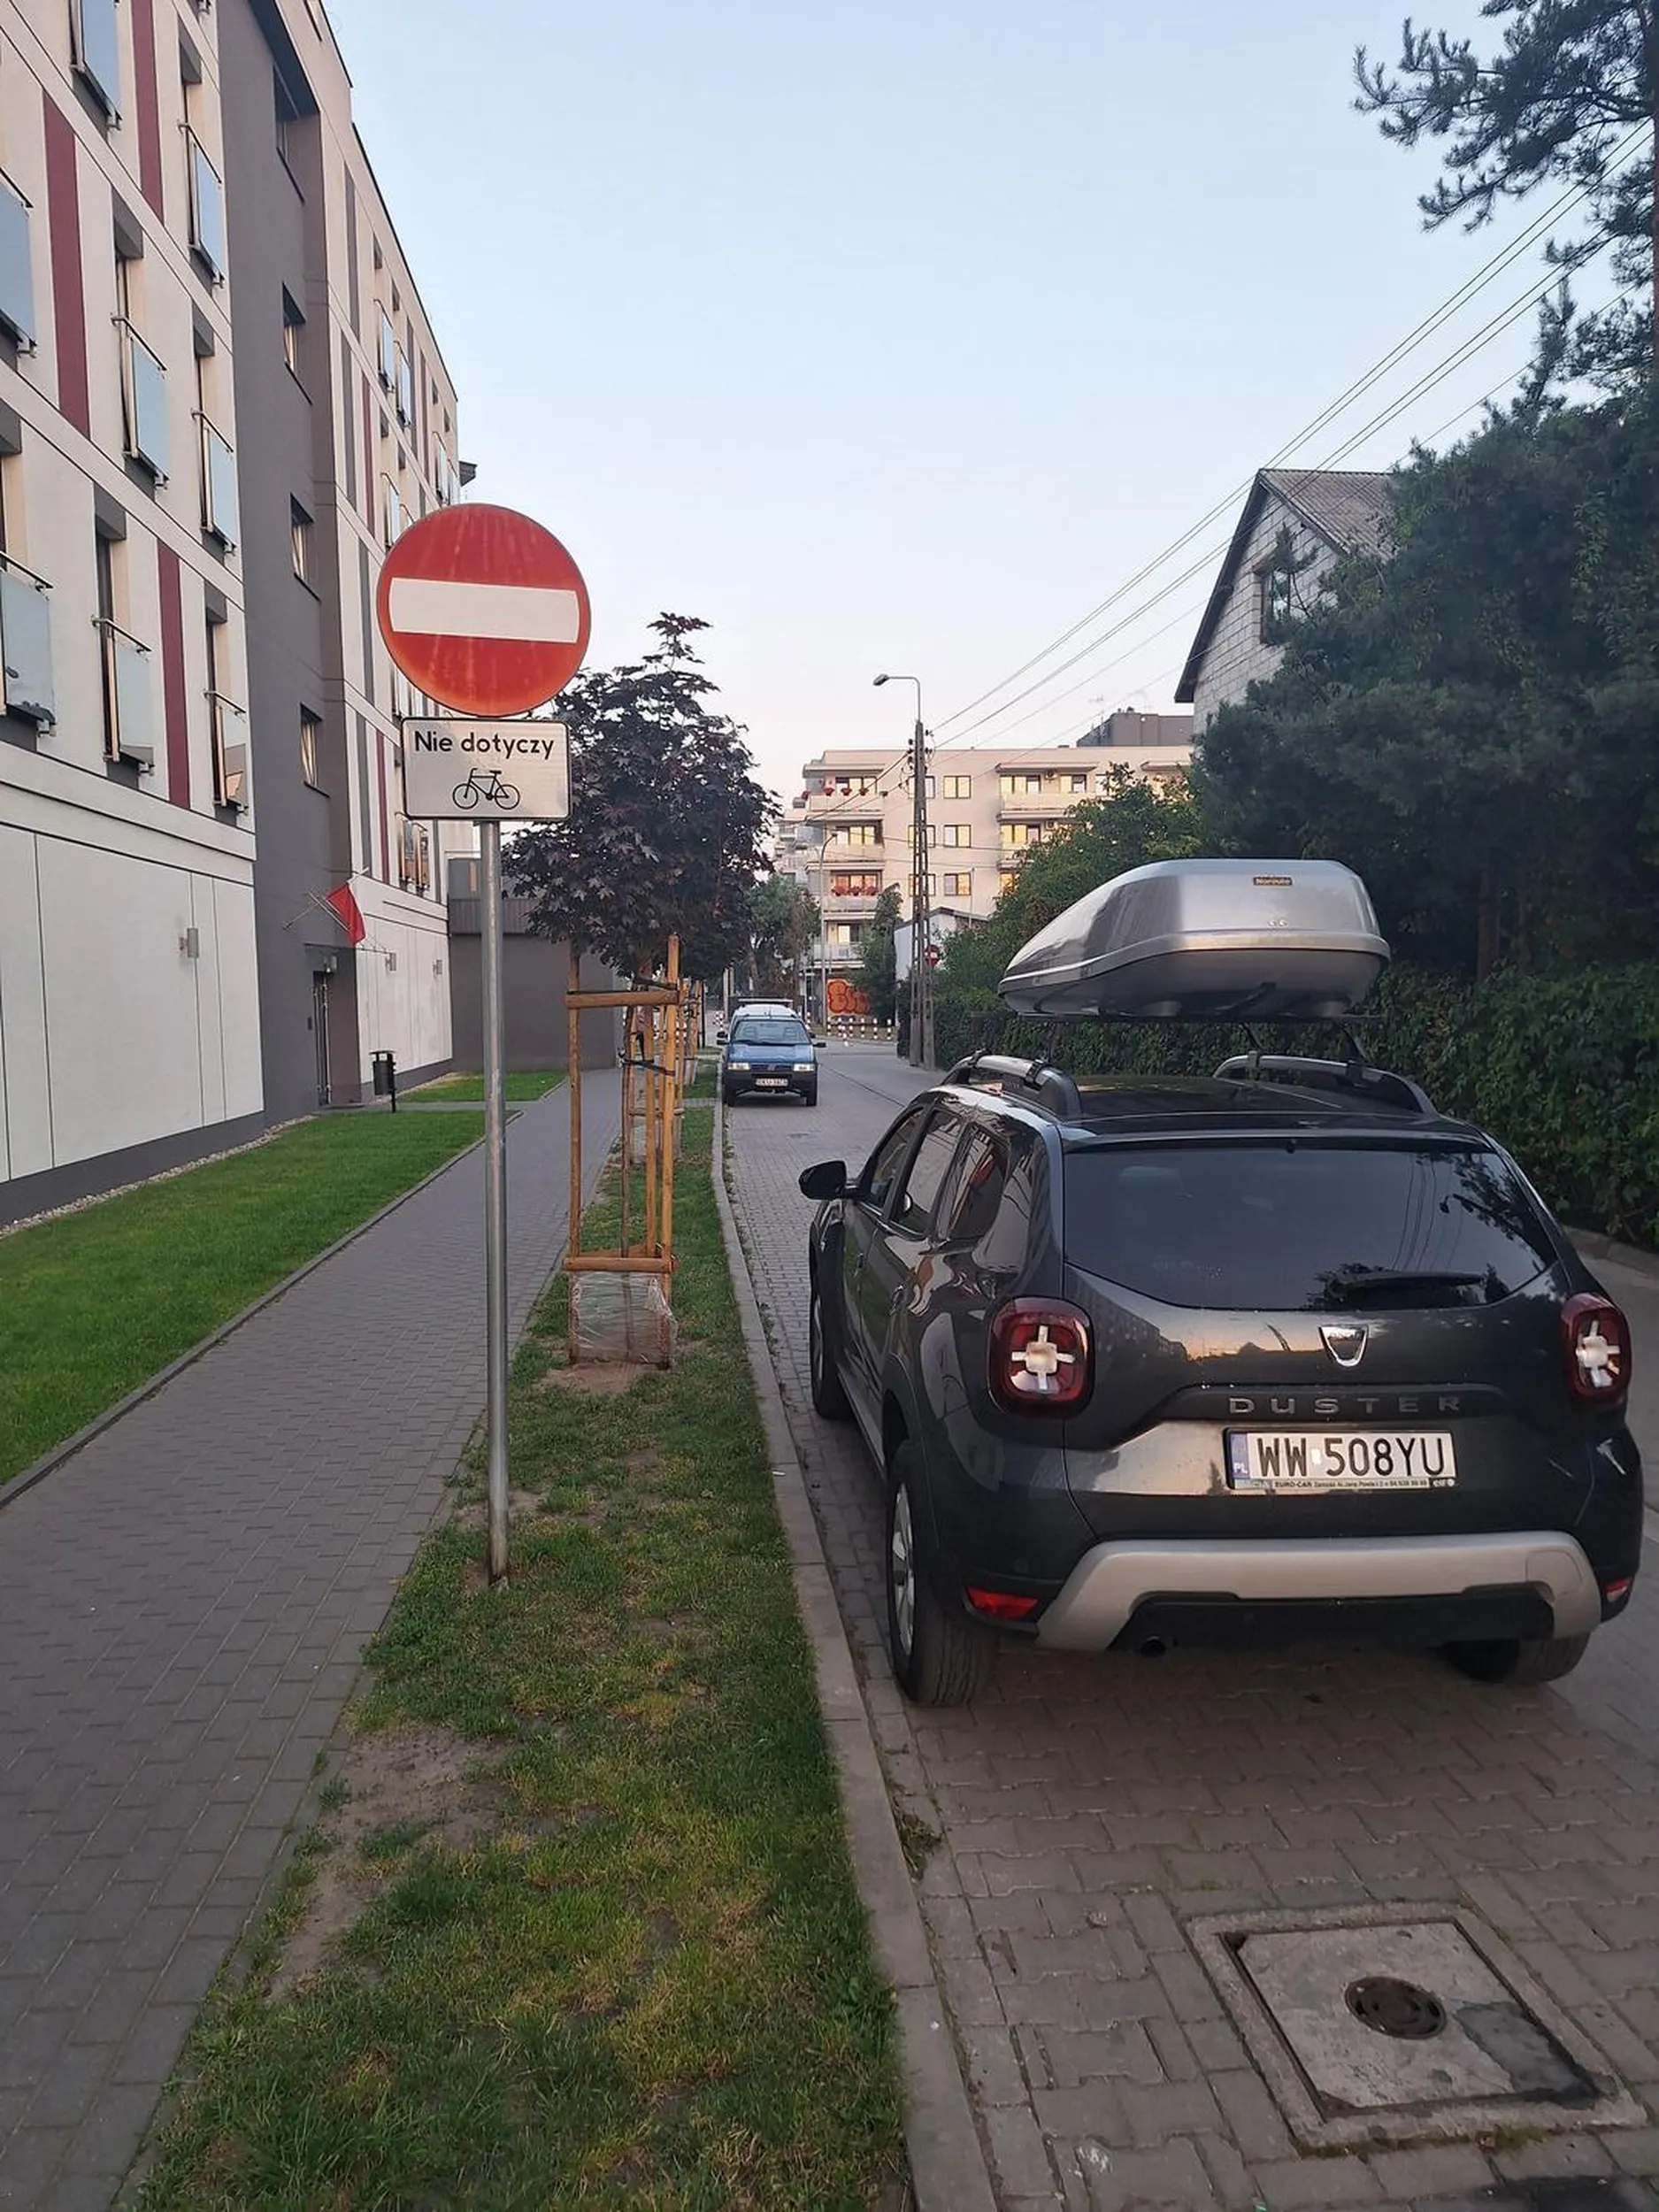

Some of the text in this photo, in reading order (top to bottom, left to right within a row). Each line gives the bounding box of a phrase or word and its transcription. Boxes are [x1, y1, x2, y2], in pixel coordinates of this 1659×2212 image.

[414, 731, 555, 760] Nie dotyczy
[1229, 1397, 1460, 1414] DUSTER
[1233, 1463, 1248, 1474] PL
[1256, 1437, 1445, 1477] WW 508YU
